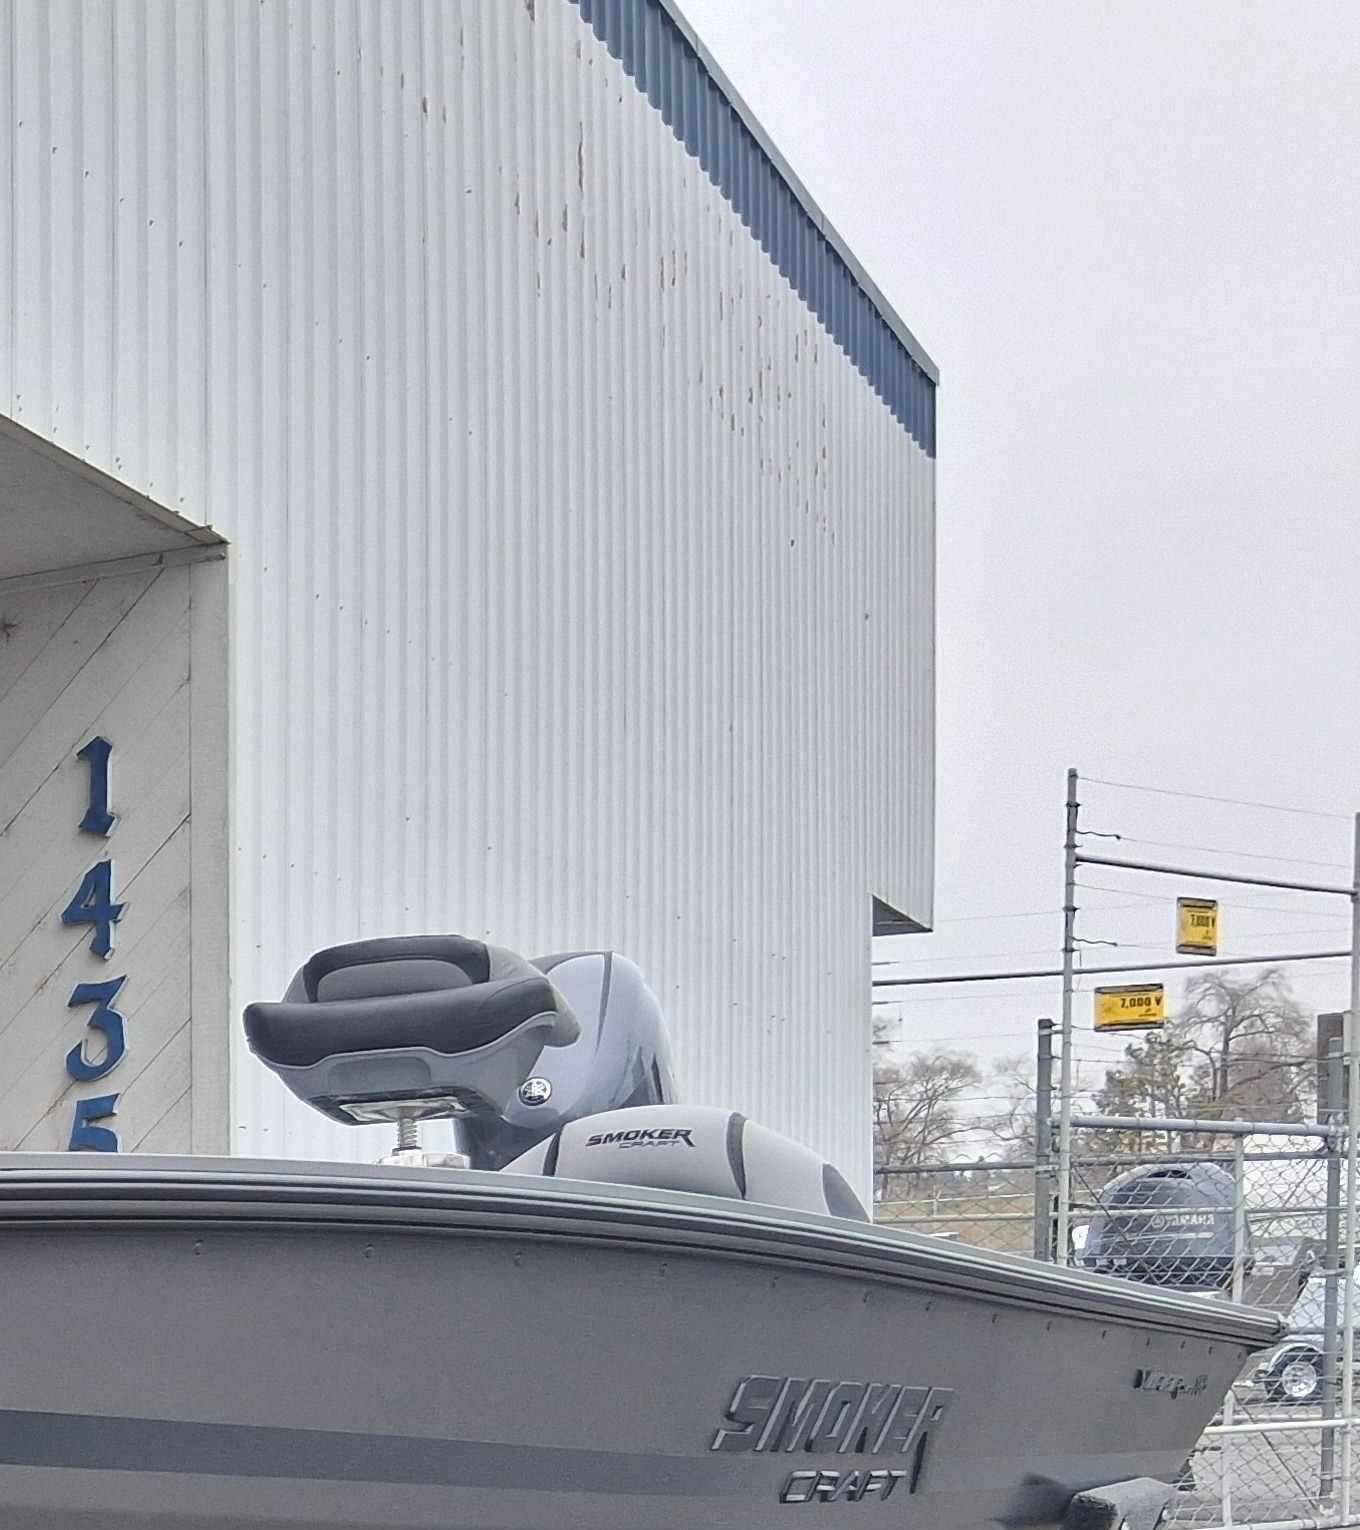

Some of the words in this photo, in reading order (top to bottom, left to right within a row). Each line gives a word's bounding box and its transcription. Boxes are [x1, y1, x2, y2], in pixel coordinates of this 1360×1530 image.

[585, 1128, 696, 1147] SMOKER
[711, 1374, 960, 1495] SMOKER
[780, 1469, 908, 1504] CRAFT
